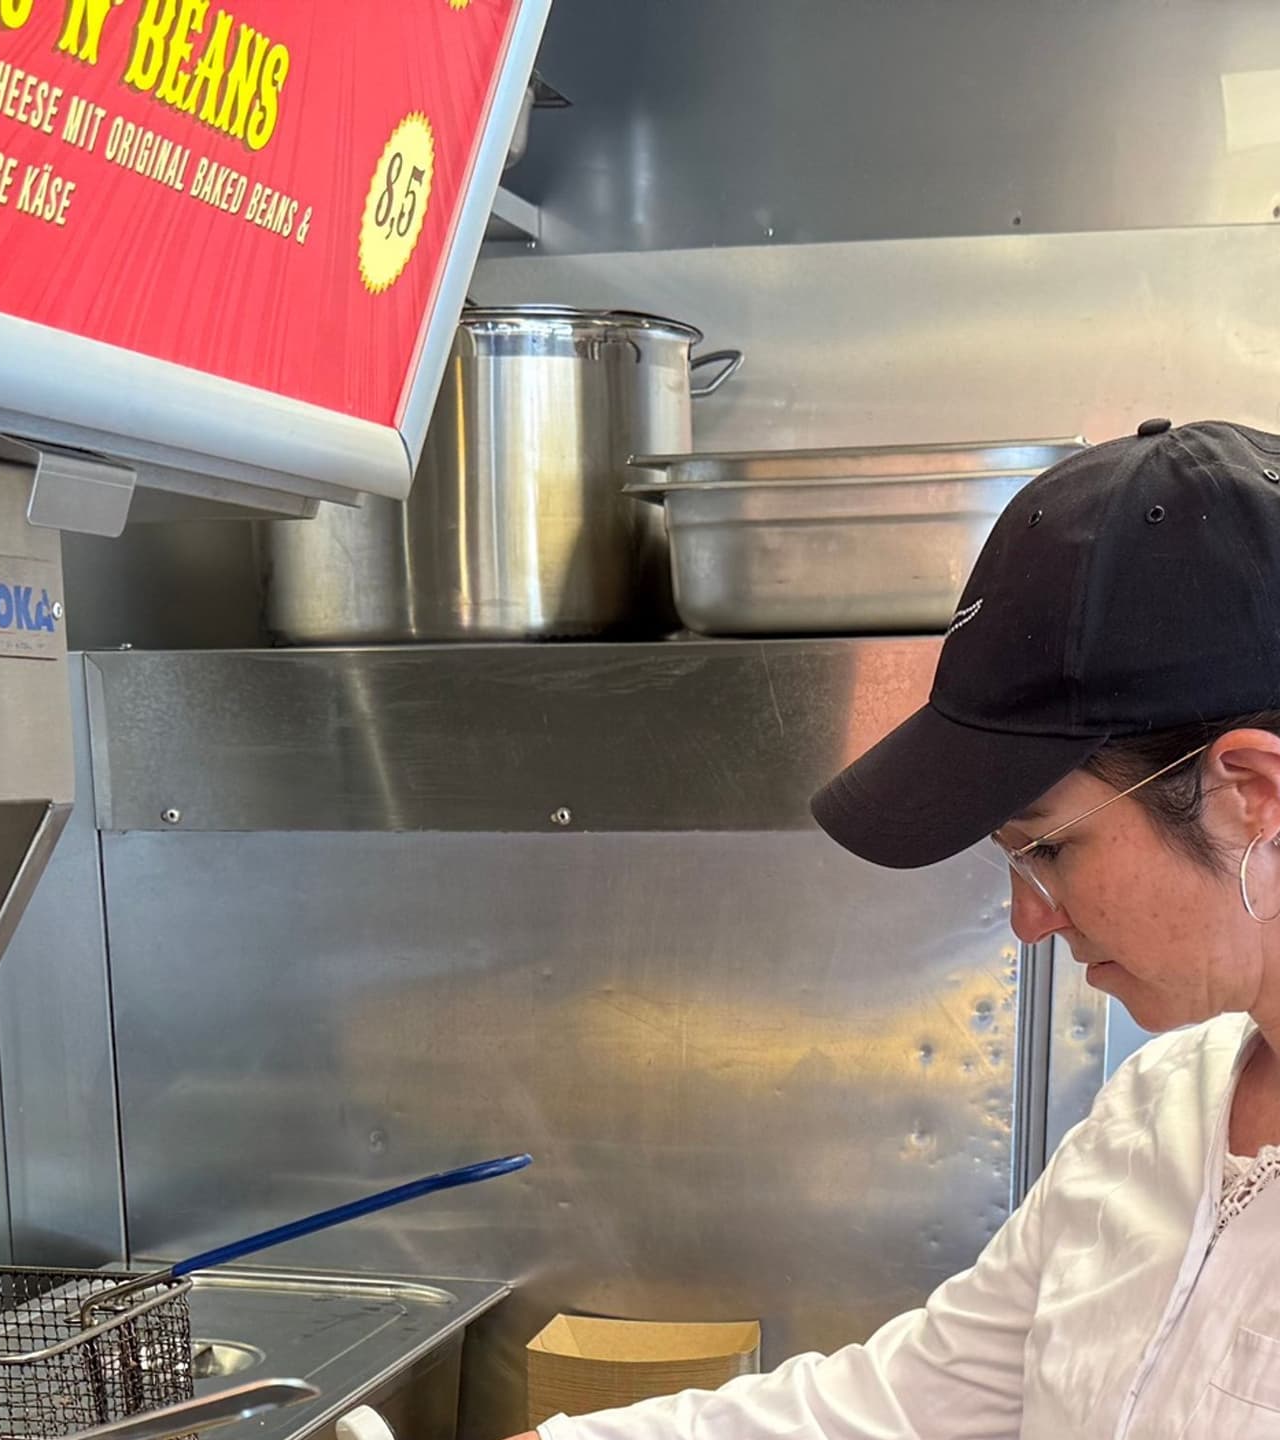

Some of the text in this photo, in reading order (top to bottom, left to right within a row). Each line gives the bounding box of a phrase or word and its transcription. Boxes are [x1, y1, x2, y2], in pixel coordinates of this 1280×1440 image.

[124, 0, 290, 150] BEANS
[16, 164, 75, 225] KÄSE
[62, 96, 107, 152] MIT
[105, 116, 191, 191] ORIGINAL
[190, 157, 248, 214] BAKED
[245, 182, 298, 238] BEANS
[296, 206, 312, 244] &
[375, 152, 425, 240] 8,5
